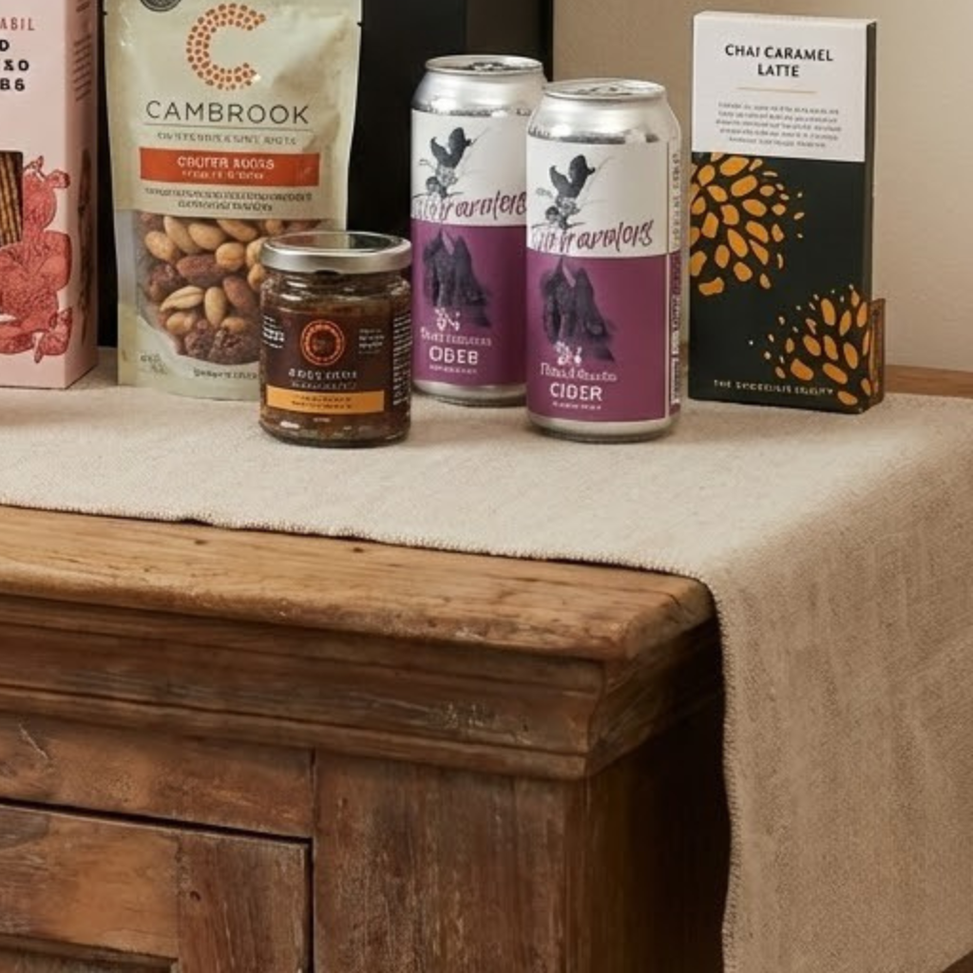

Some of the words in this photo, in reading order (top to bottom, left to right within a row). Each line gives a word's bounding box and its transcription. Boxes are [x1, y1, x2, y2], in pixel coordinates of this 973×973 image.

[725, 43, 761, 58] CHAI
[763, 46, 834, 61] CARAMEL
[757, 63, 800, 78] LATTE
[146, 100, 310, 125] CAMBROOK
